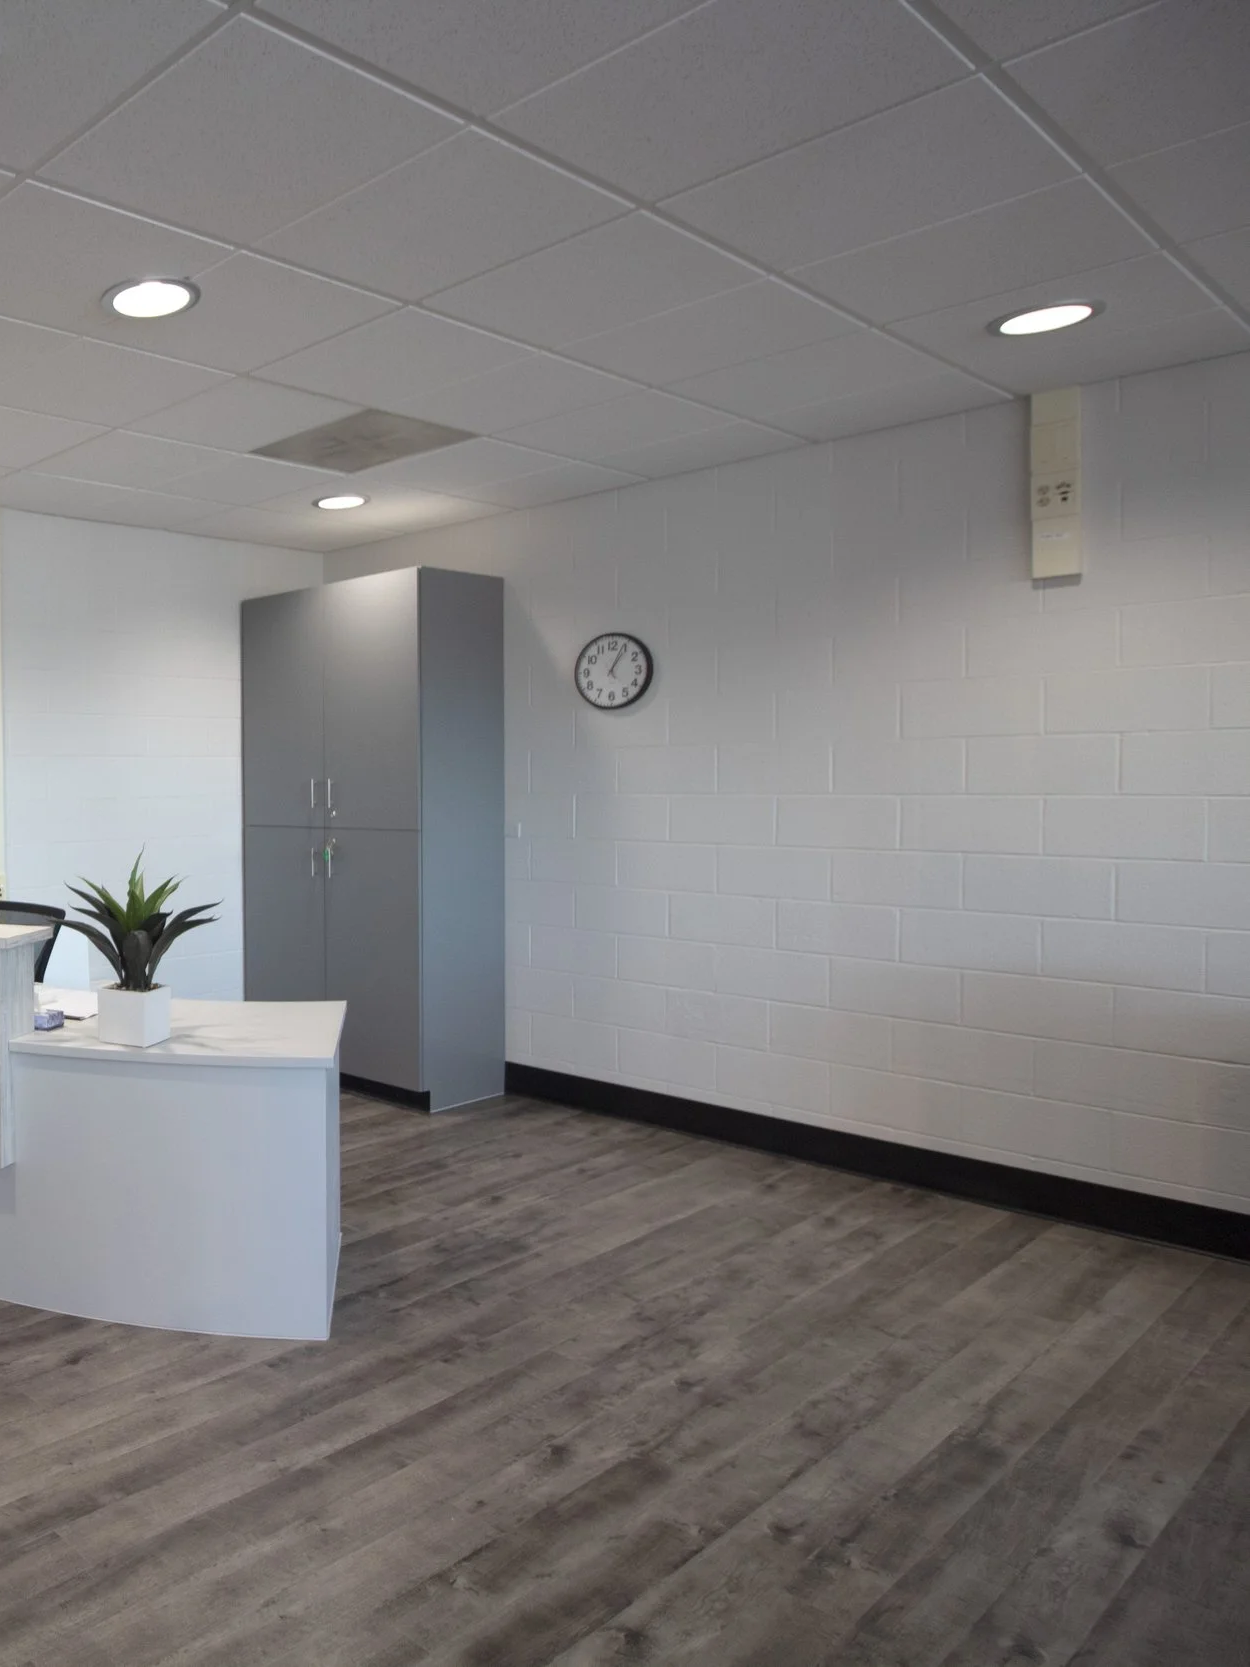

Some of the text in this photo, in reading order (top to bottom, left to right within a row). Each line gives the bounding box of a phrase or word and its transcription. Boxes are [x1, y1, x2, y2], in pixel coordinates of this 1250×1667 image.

[597, 645, 605, 655] 11
[607, 641, 618, 651] 12
[587, 655, 597, 665] 10
